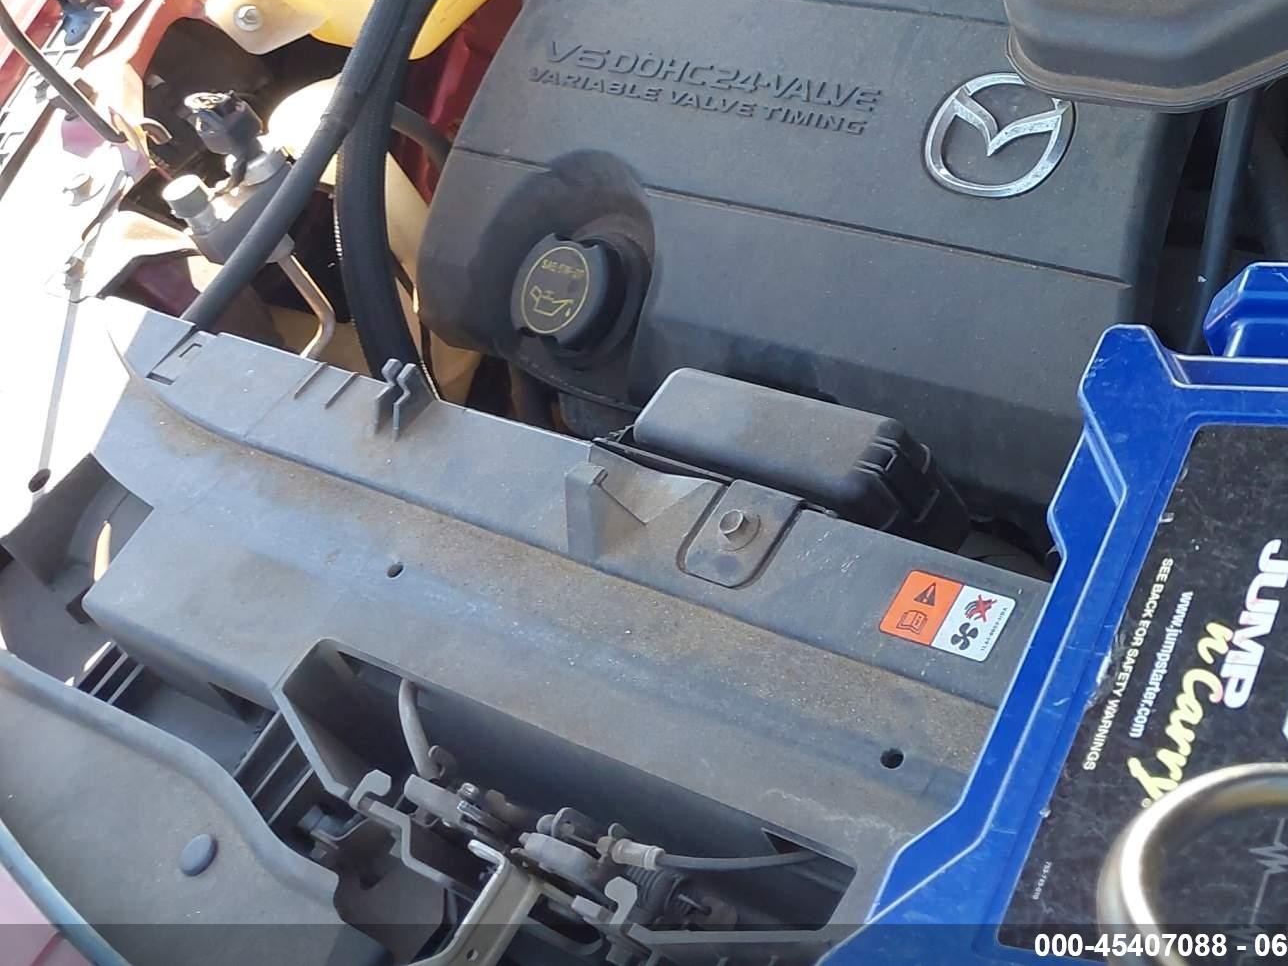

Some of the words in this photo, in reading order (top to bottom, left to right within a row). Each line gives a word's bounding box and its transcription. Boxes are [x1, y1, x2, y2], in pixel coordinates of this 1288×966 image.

[608, 52, 715, 87] DOHC
[528, 66, 664, 103] VARIABLE
[670, 90, 758, 118] VALVE
[763, 106, 868, 136] TIMING
[1155, 557, 1174, 583] SEE
[1144, 583, 1165, 619] BACK
[1130, 617, 1152, 651] FOR
[1114, 649, 1140, 699] SAFETY
[1129, 591, 1194, 738] www.jumpstarter.com
[1083, 698, 1121, 771] WARNINGS
